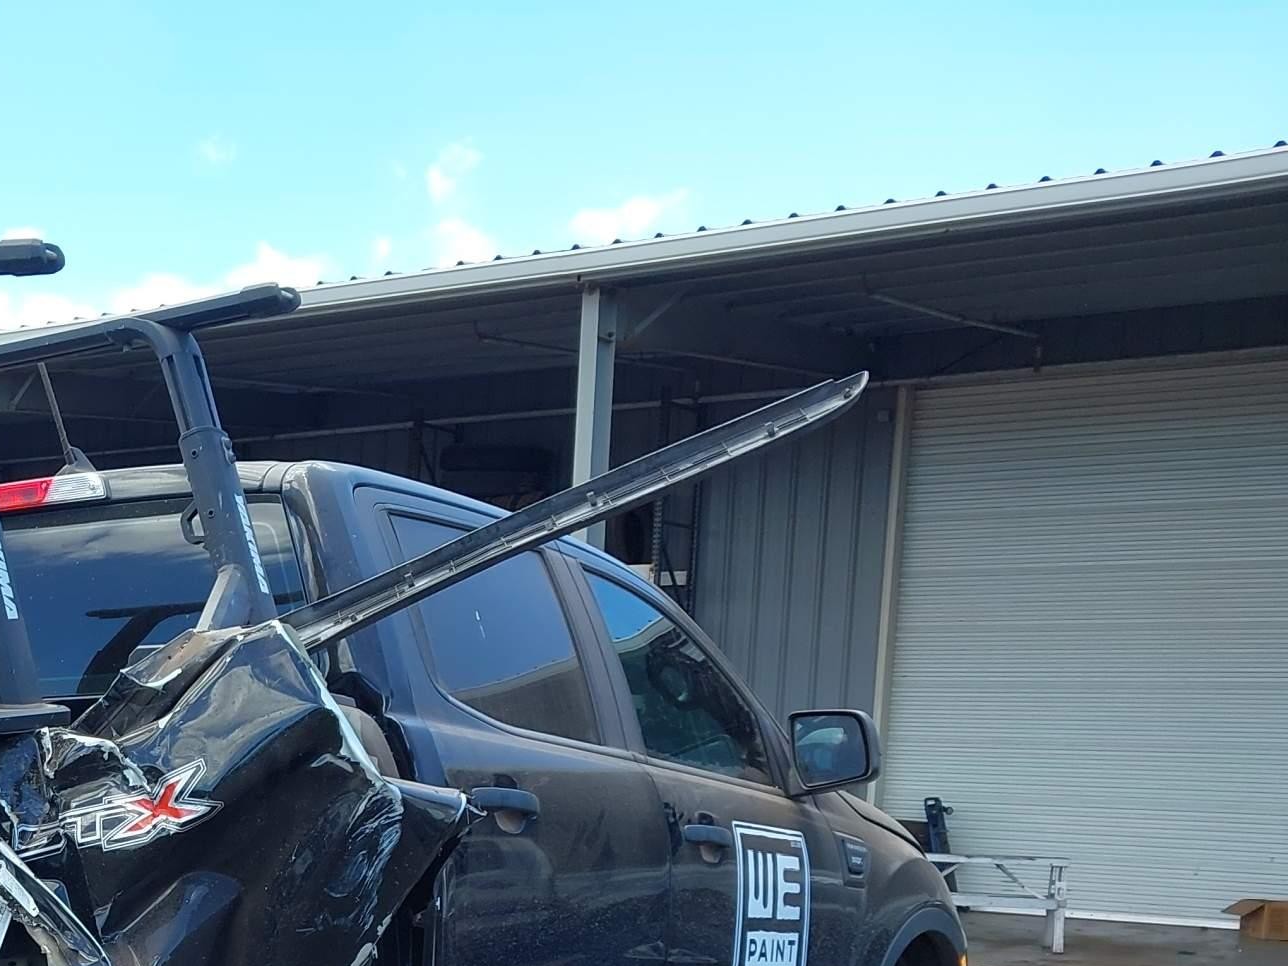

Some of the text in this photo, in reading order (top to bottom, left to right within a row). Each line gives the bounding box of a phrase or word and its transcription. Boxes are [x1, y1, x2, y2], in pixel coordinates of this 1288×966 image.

[234, 494, 270, 594] YAKIMA
[747, 849, 801, 920] WE
[747, 938, 796, 963] PAINT
